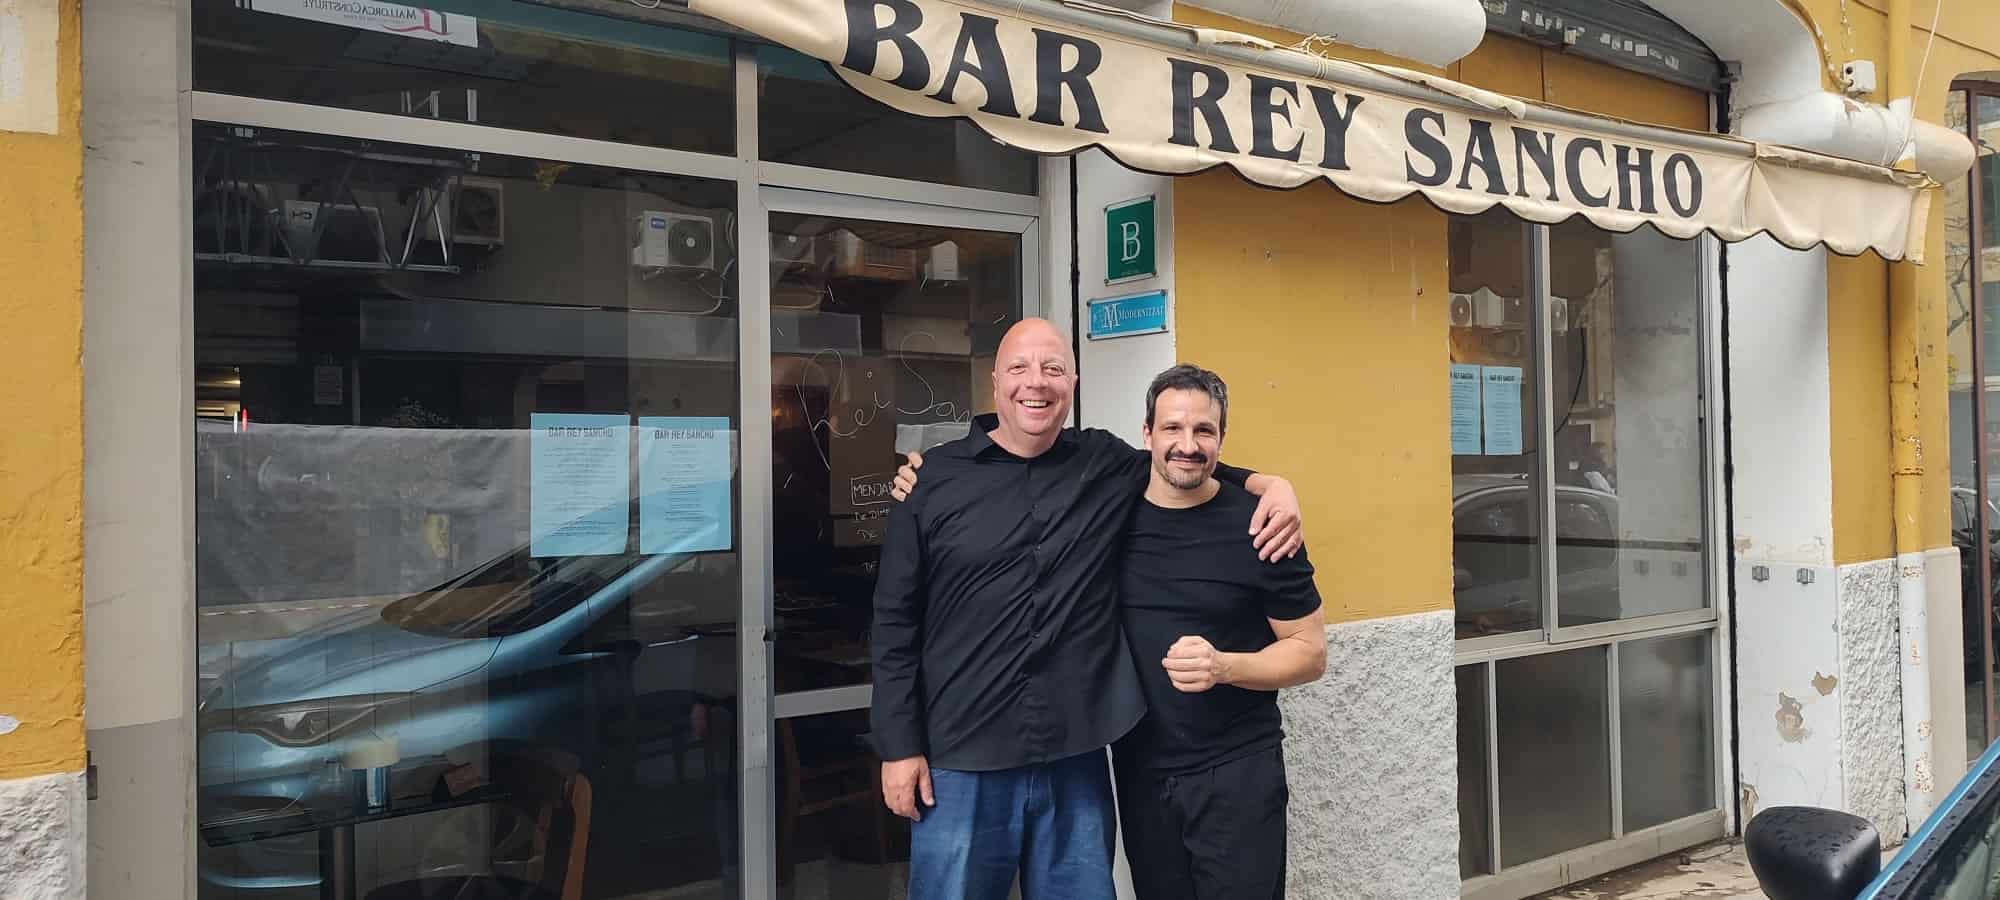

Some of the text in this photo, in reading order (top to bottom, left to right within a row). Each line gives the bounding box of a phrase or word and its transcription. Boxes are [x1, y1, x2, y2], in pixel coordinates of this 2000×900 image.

[841, 0, 1704, 219] BAR REY SANCHO
